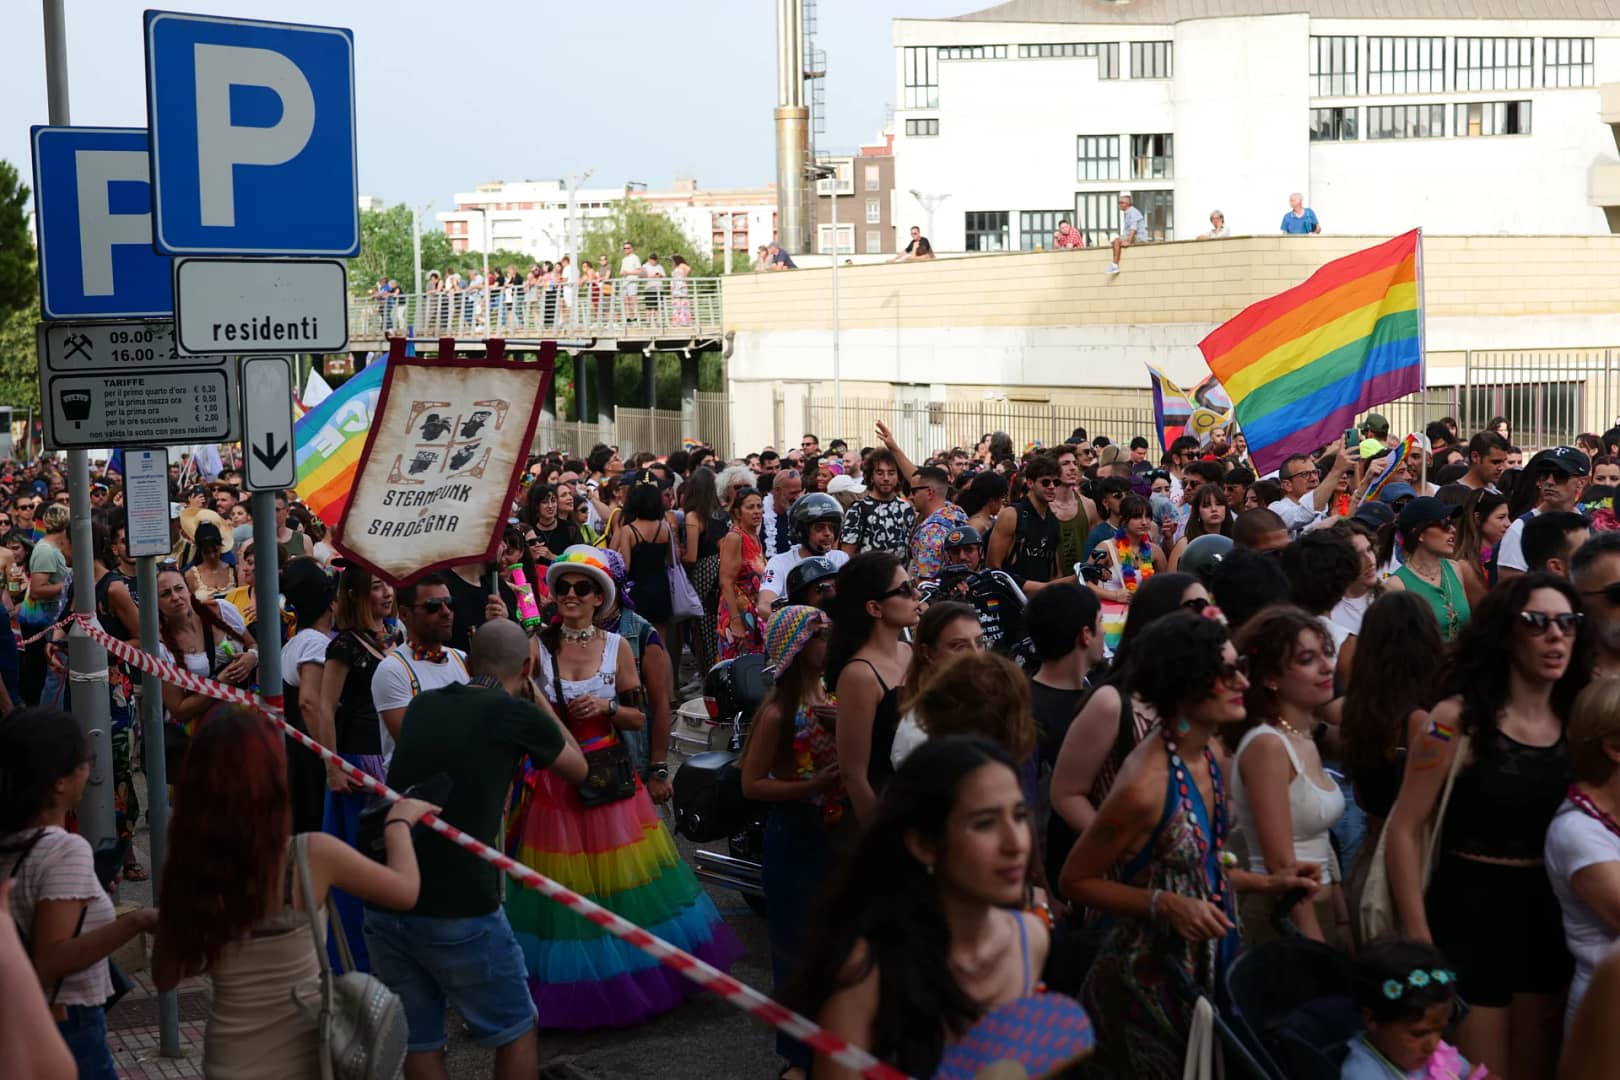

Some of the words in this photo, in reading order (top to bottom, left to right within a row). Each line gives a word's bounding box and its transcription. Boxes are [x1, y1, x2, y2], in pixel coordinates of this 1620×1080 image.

[194, 42, 316, 227] P
[212, 316, 318, 342] residenti
[109, 330, 153, 344] 09.00
[111, 348, 154, 362] 16.00
[103, 378, 145, 387] TARIFFE
[104, 390, 116, 399] per
[117, 388, 122, 397] il
[123, 389, 144, 398] primo
[145, 387, 168, 397] quarto
[169, 385, 187, 394] d'ora
[104, 400, 116, 408] per
[117, 398, 124, 406] la
[126, 399, 146, 407] prima
[147, 397, 169, 405] mezza
[105, 409, 117, 417] per
[119, 407, 125, 416] la
[126, 408, 147, 417] prima
[147, 407, 160, 415] ora
[105, 419, 118, 427] per
[140, 415, 179, 425] successive
[88, 431, 103, 439] non
[104, 428, 126, 437] valida
[126, 428, 133, 437] la
[135, 428, 154, 437] sosta
[155, 428, 168, 436] con
[187, 424, 218, 434] residenti
[383, 484, 473, 507] STEAMPUNK
[368, 514, 460, 537] SARDEGNA
